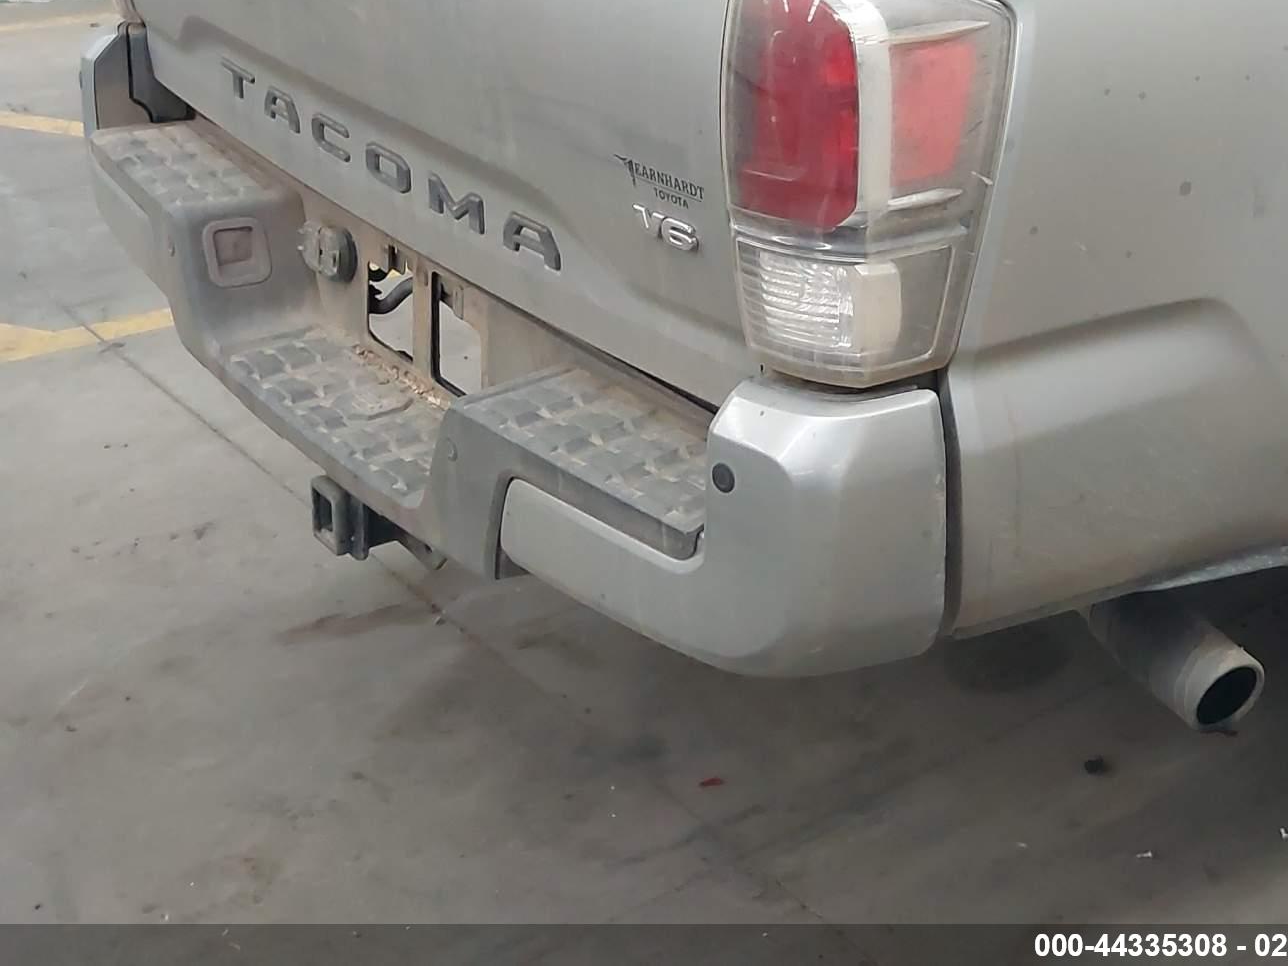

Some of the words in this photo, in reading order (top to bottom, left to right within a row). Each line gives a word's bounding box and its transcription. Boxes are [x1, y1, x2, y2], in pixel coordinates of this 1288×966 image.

[220, 56, 562, 272] TACOMA
[634, 161, 705, 200] EARNHARDT
[653, 186, 690, 210] TOYOTA
[632, 203, 700, 252] V6
